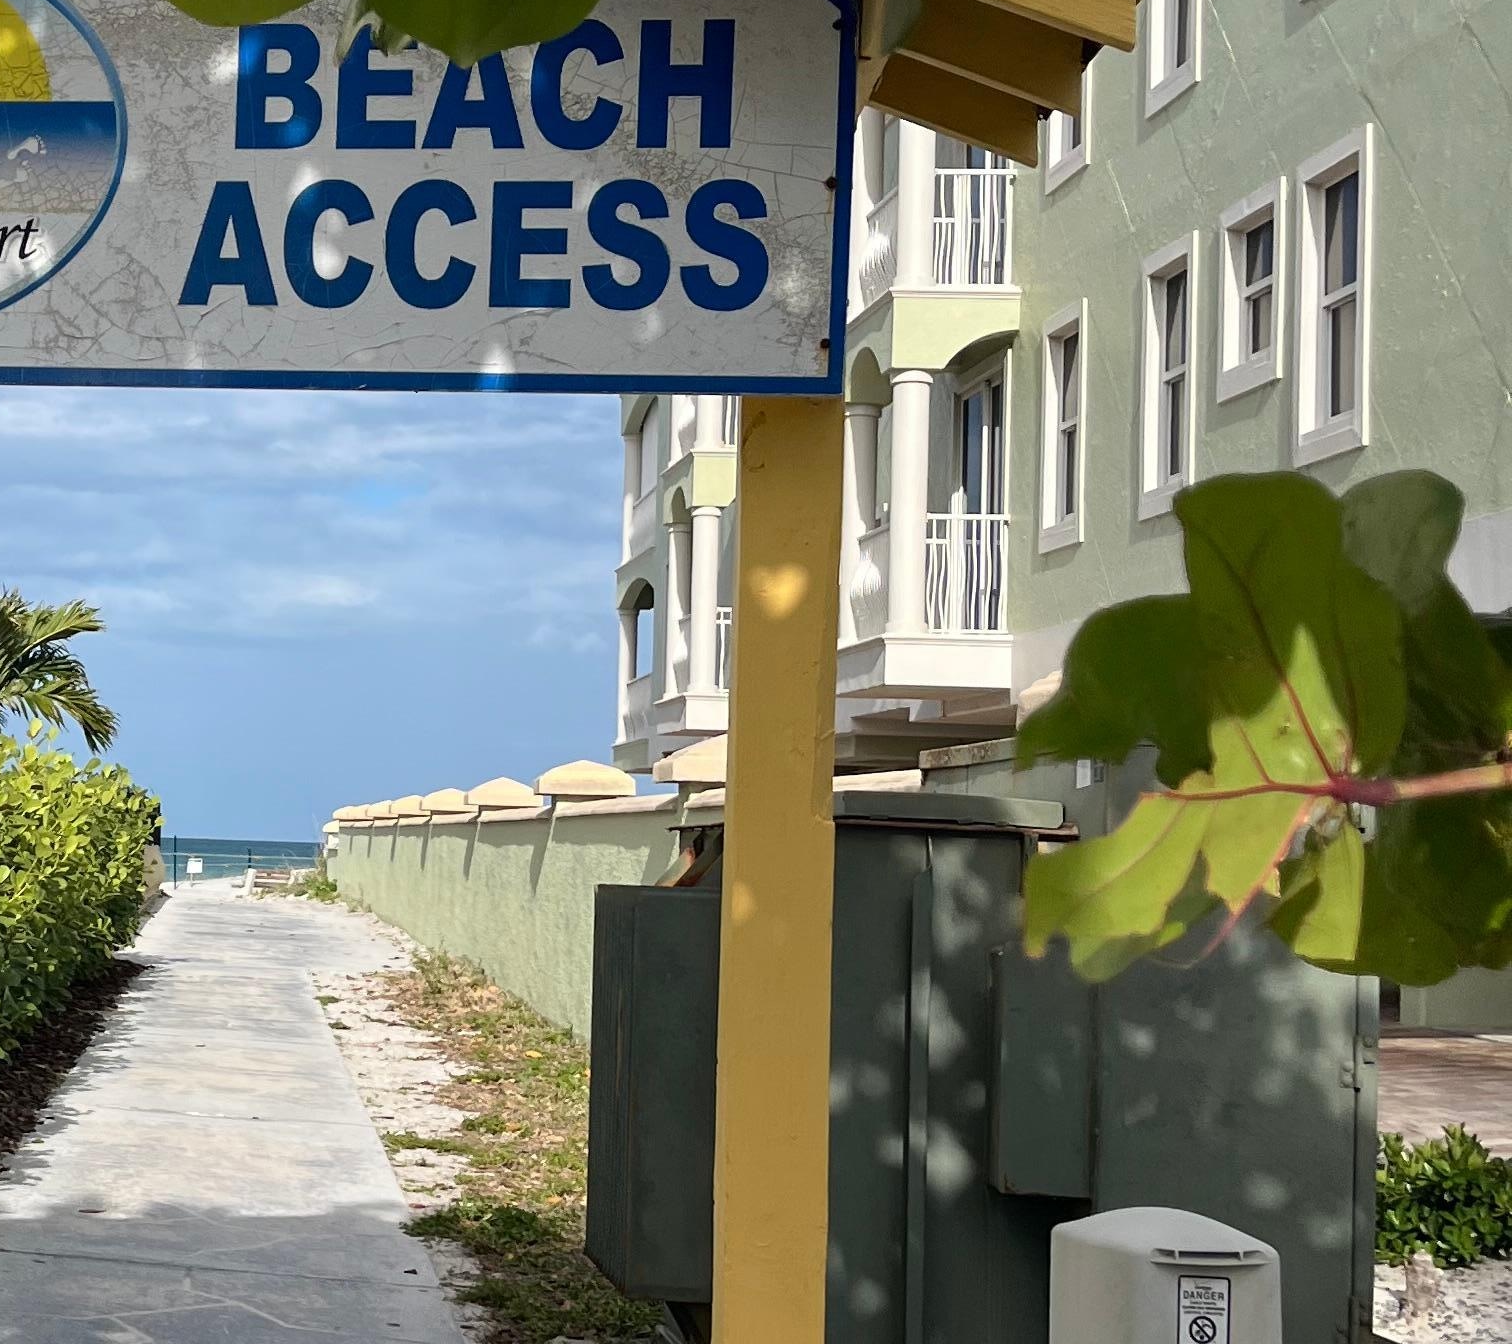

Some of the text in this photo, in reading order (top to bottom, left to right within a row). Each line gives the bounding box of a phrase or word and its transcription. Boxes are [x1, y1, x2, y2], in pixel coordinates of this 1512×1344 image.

[234, 18, 736, 150] BEACH
[178, 178, 769, 311] ACCESS
[1183, 1289, 1225, 1301] DANGER
